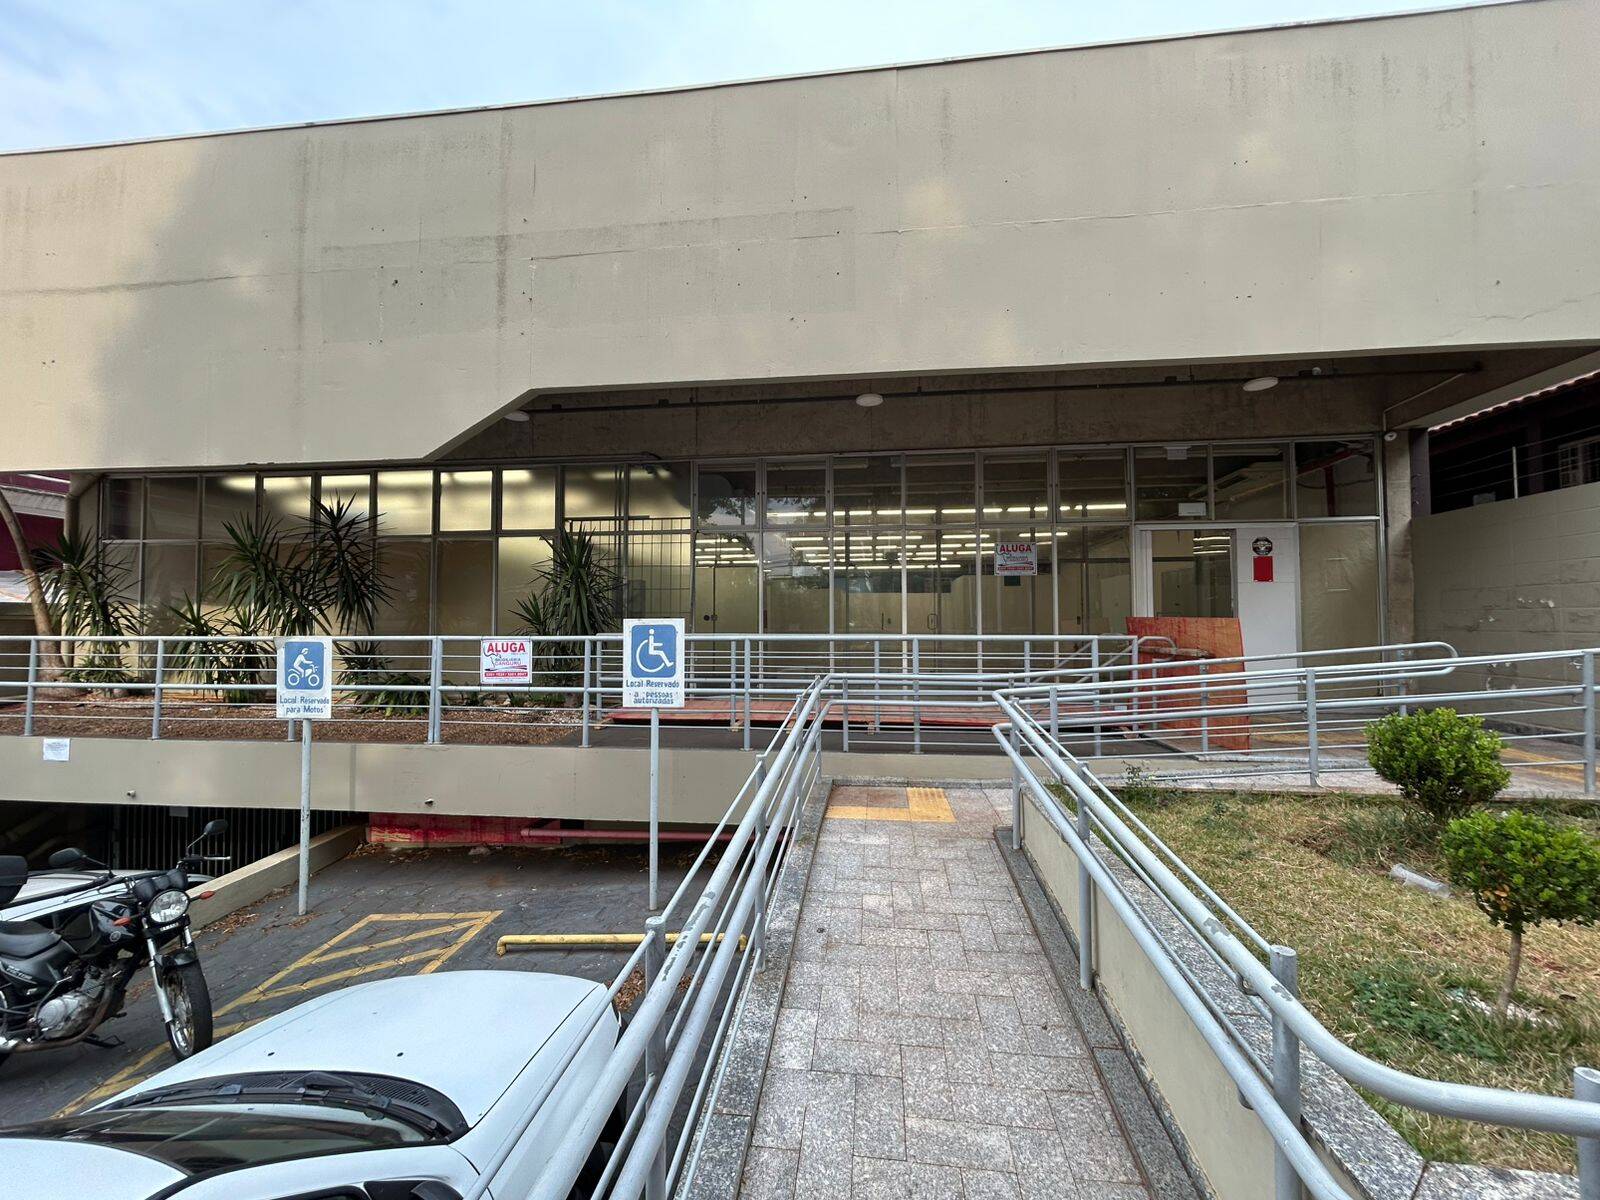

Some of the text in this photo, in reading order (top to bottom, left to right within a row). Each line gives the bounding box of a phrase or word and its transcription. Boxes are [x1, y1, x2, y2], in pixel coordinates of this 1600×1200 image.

[1000, 544, 1031, 552] ALUGA
[487, 643, 525, 652] ALUGA
[280, 695, 329, 704] Local Reservado
[286, 707, 300, 715] para
